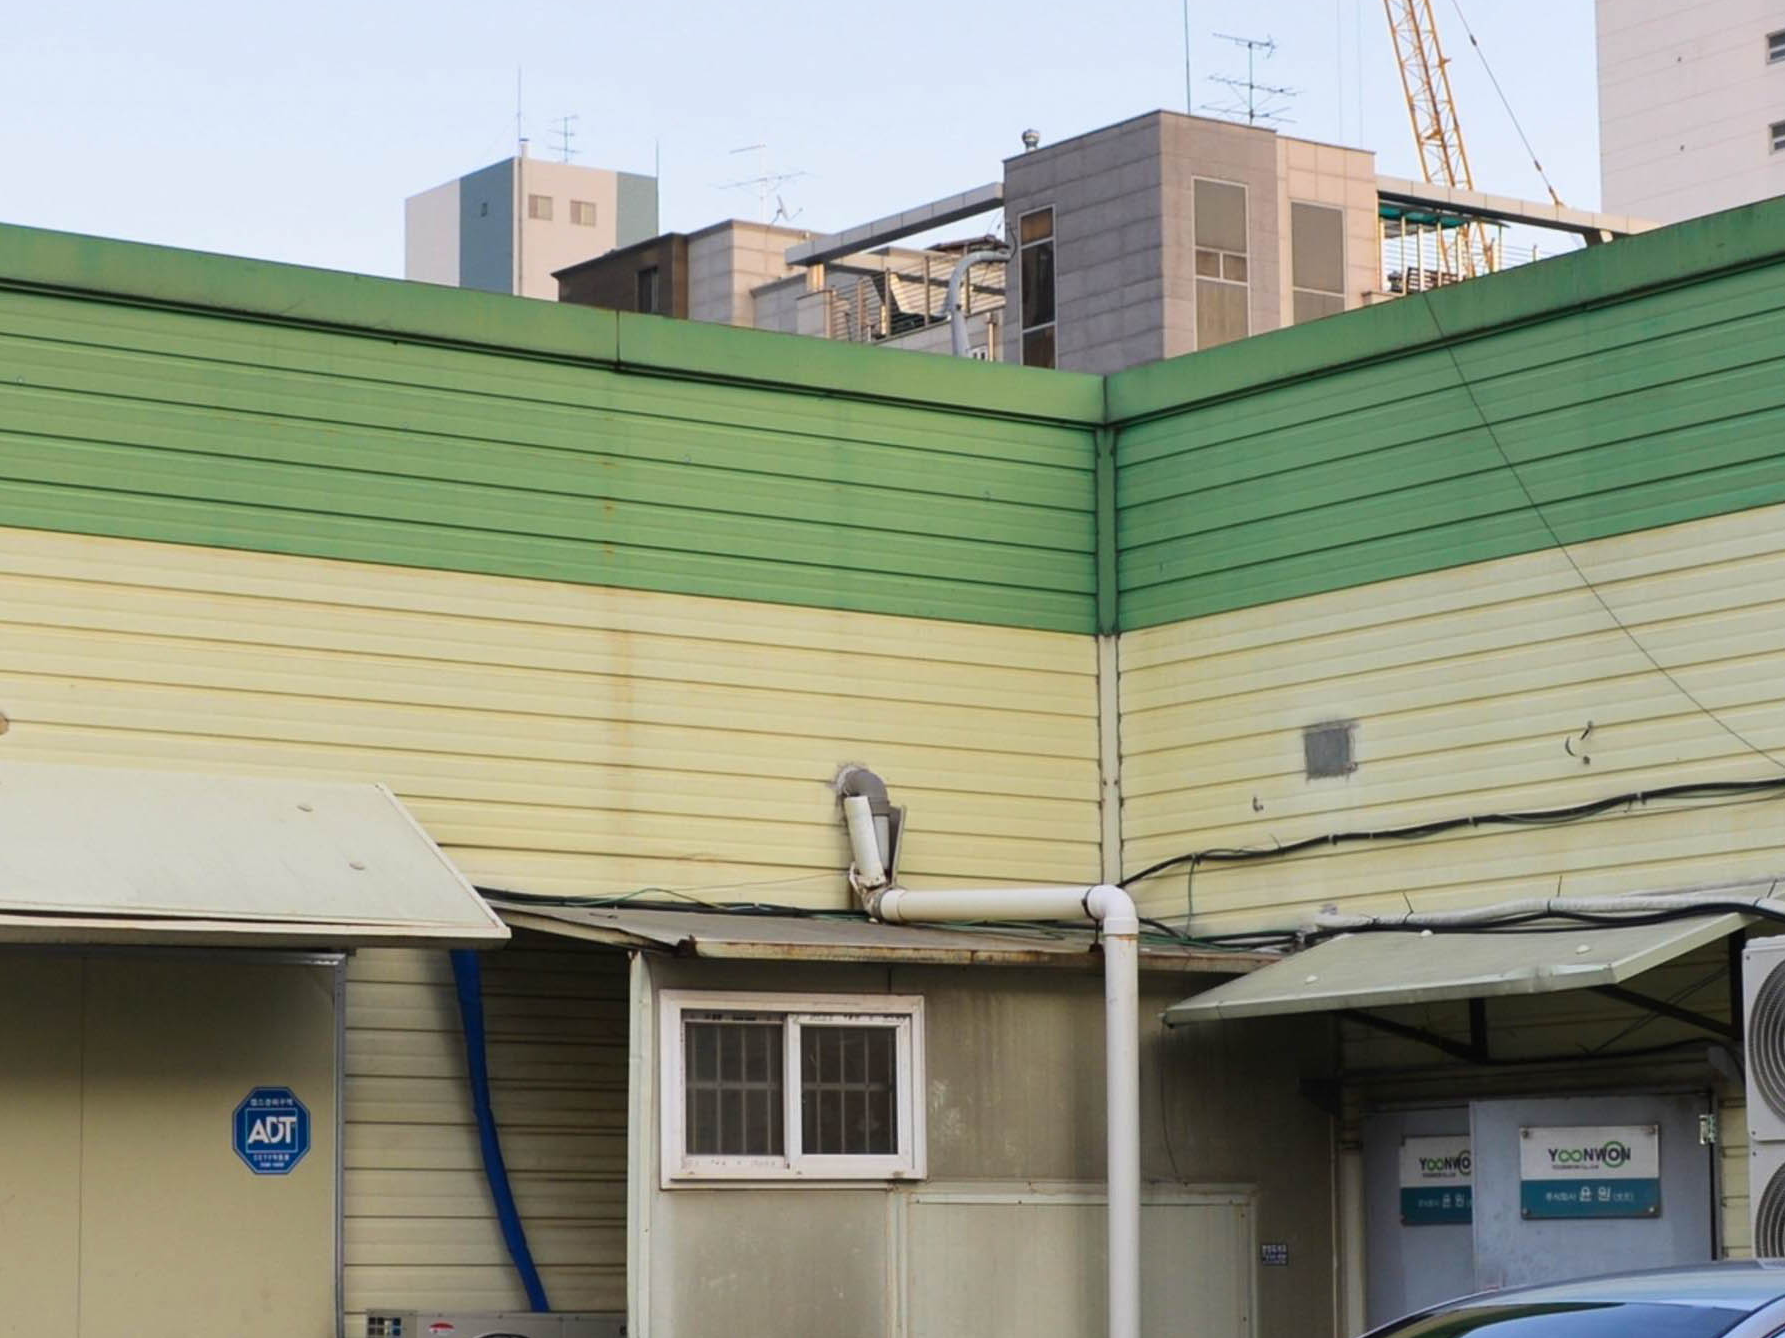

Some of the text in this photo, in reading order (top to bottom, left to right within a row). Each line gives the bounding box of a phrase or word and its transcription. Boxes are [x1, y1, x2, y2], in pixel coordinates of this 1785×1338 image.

[248, 1116, 297, 1144] ADT
[1418, 1152, 1472, 1174] YOONWO
[1548, 1144, 1632, 1166] YOONWON
